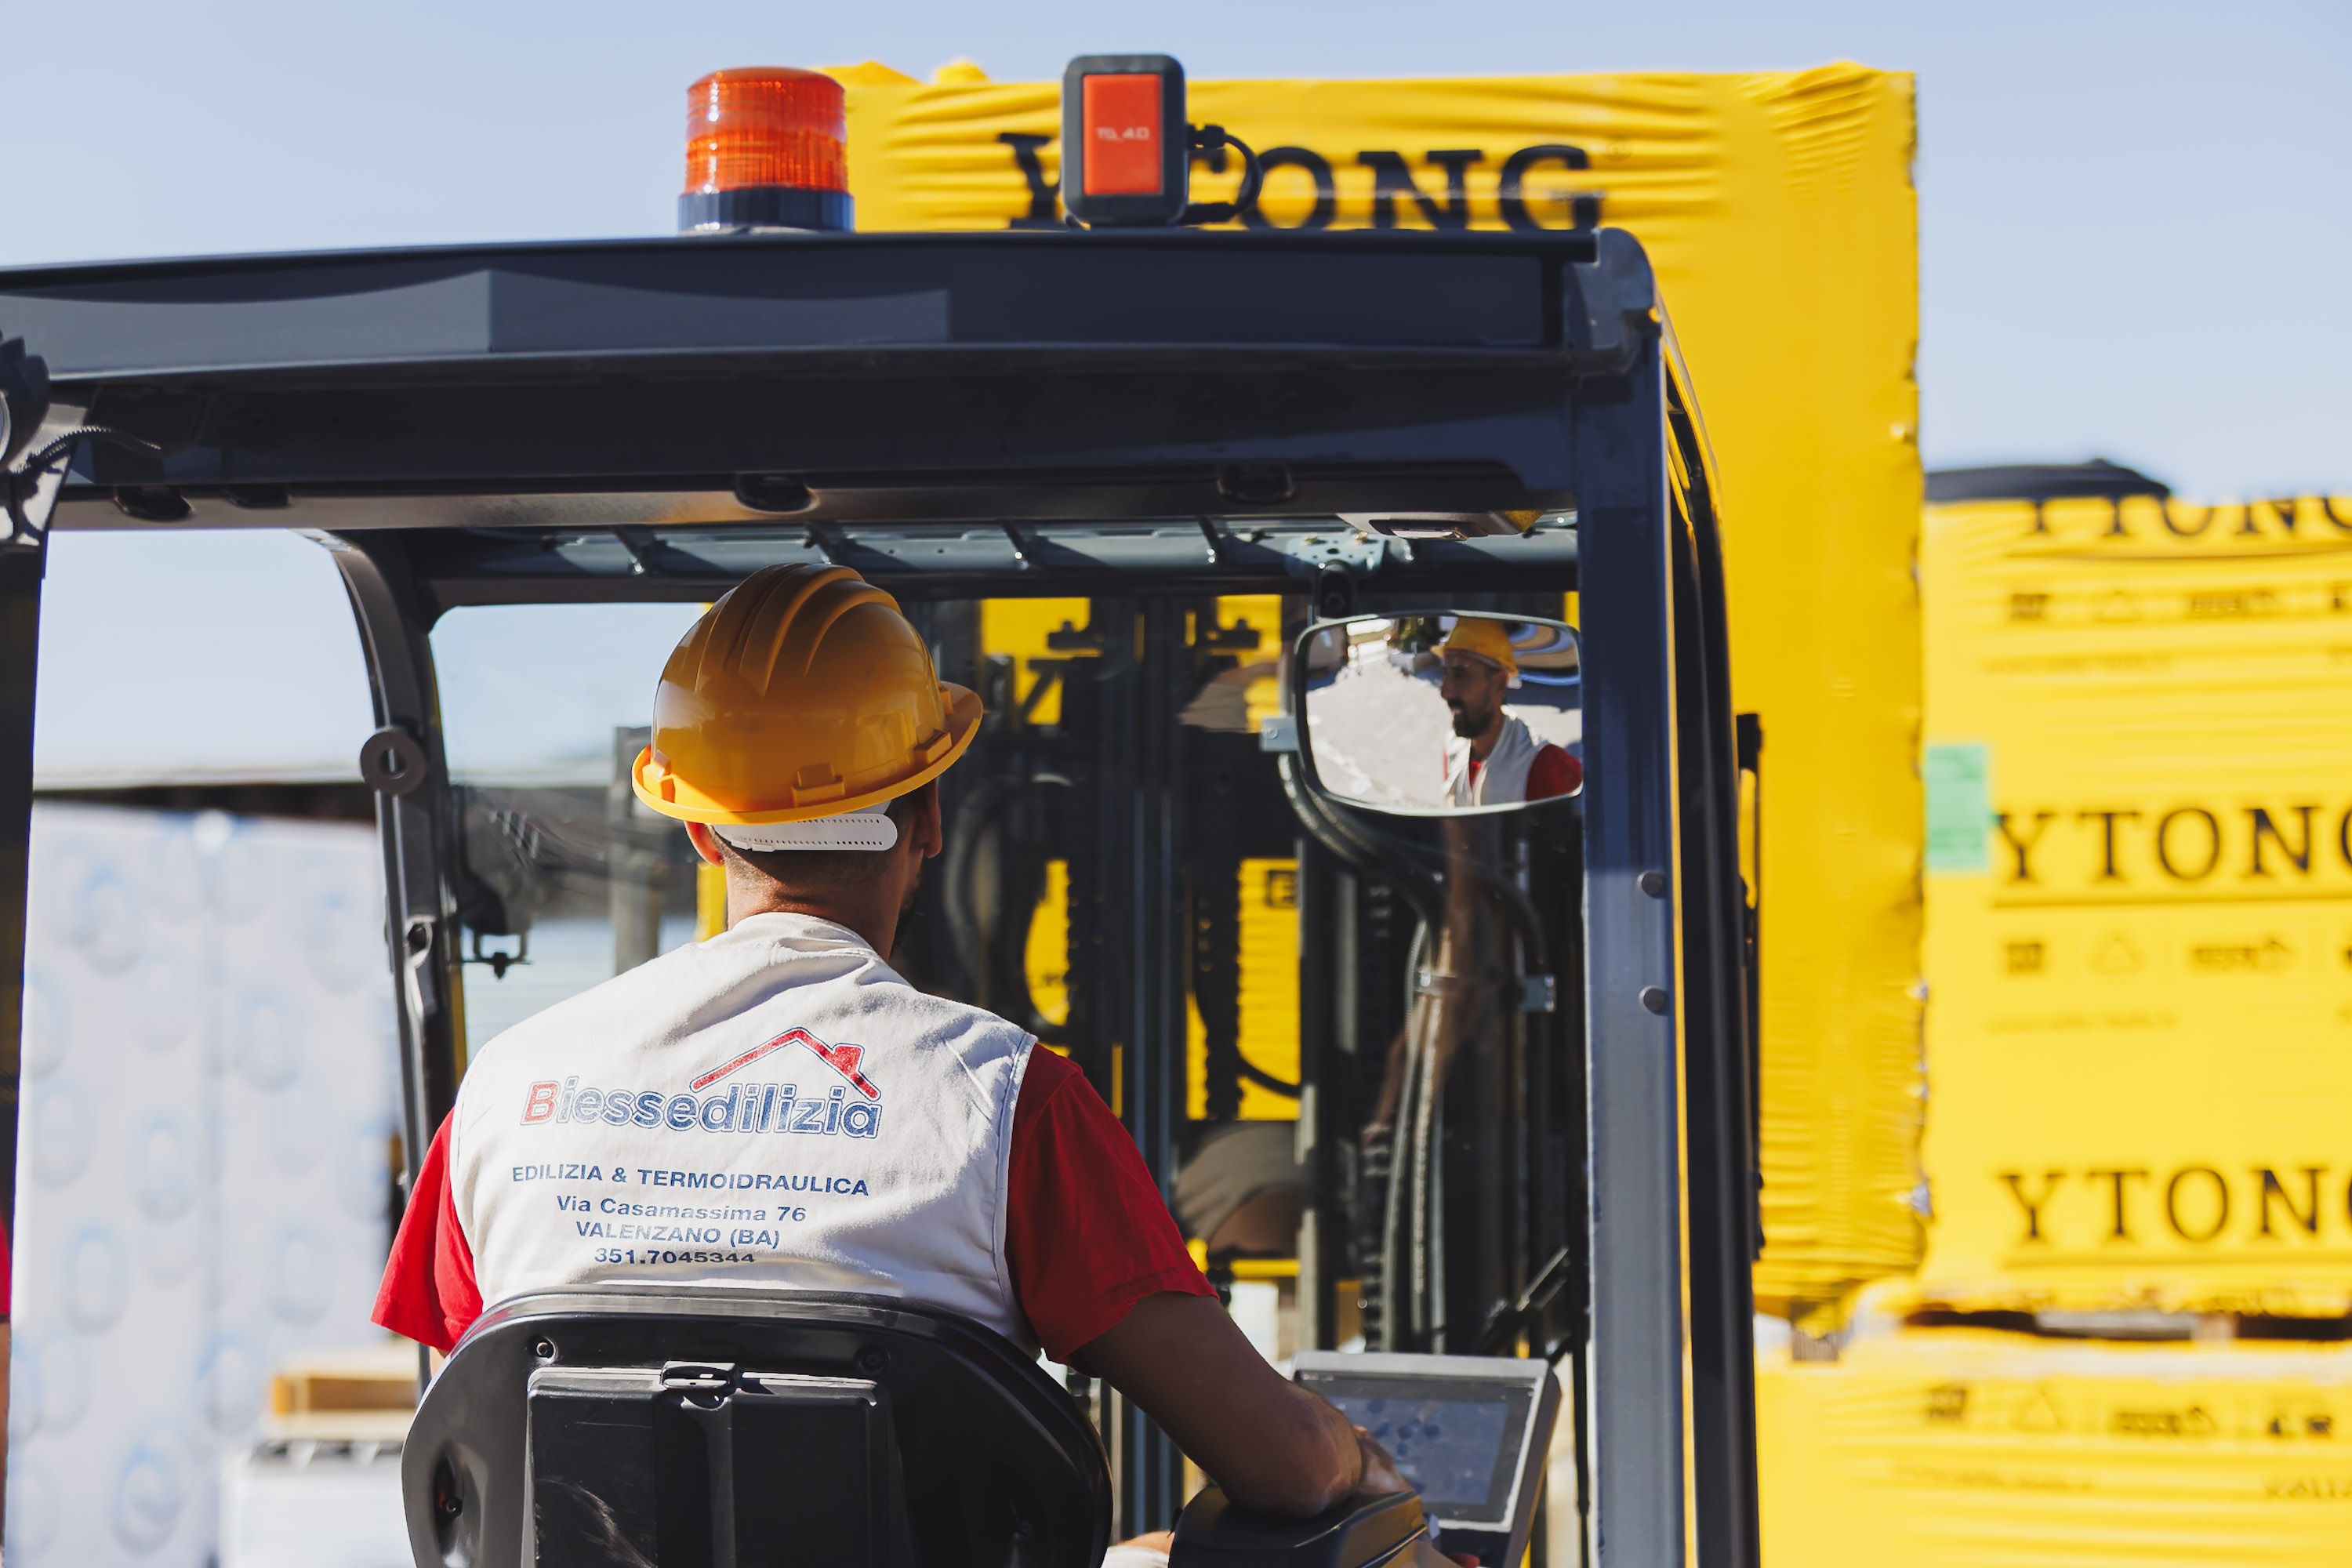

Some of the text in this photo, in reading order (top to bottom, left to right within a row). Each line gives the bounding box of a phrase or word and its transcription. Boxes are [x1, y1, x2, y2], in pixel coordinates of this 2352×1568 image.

[998, 133, 1603, 230] YONG
[1994, 806, 2352, 883] YTON
[521, 1076, 883, 1139] Biessedilizia
[512, 1163, 869, 1196] EDILIZIA & TERMOIDRAULICA
[557, 1196, 807, 1222] Via Casamassima 76
[1996, 1166, 2352, 1243] YTON
[576, 1221, 781, 1250] VALENZANO (BA)
[594, 1247, 757, 1265] 351.7045344
